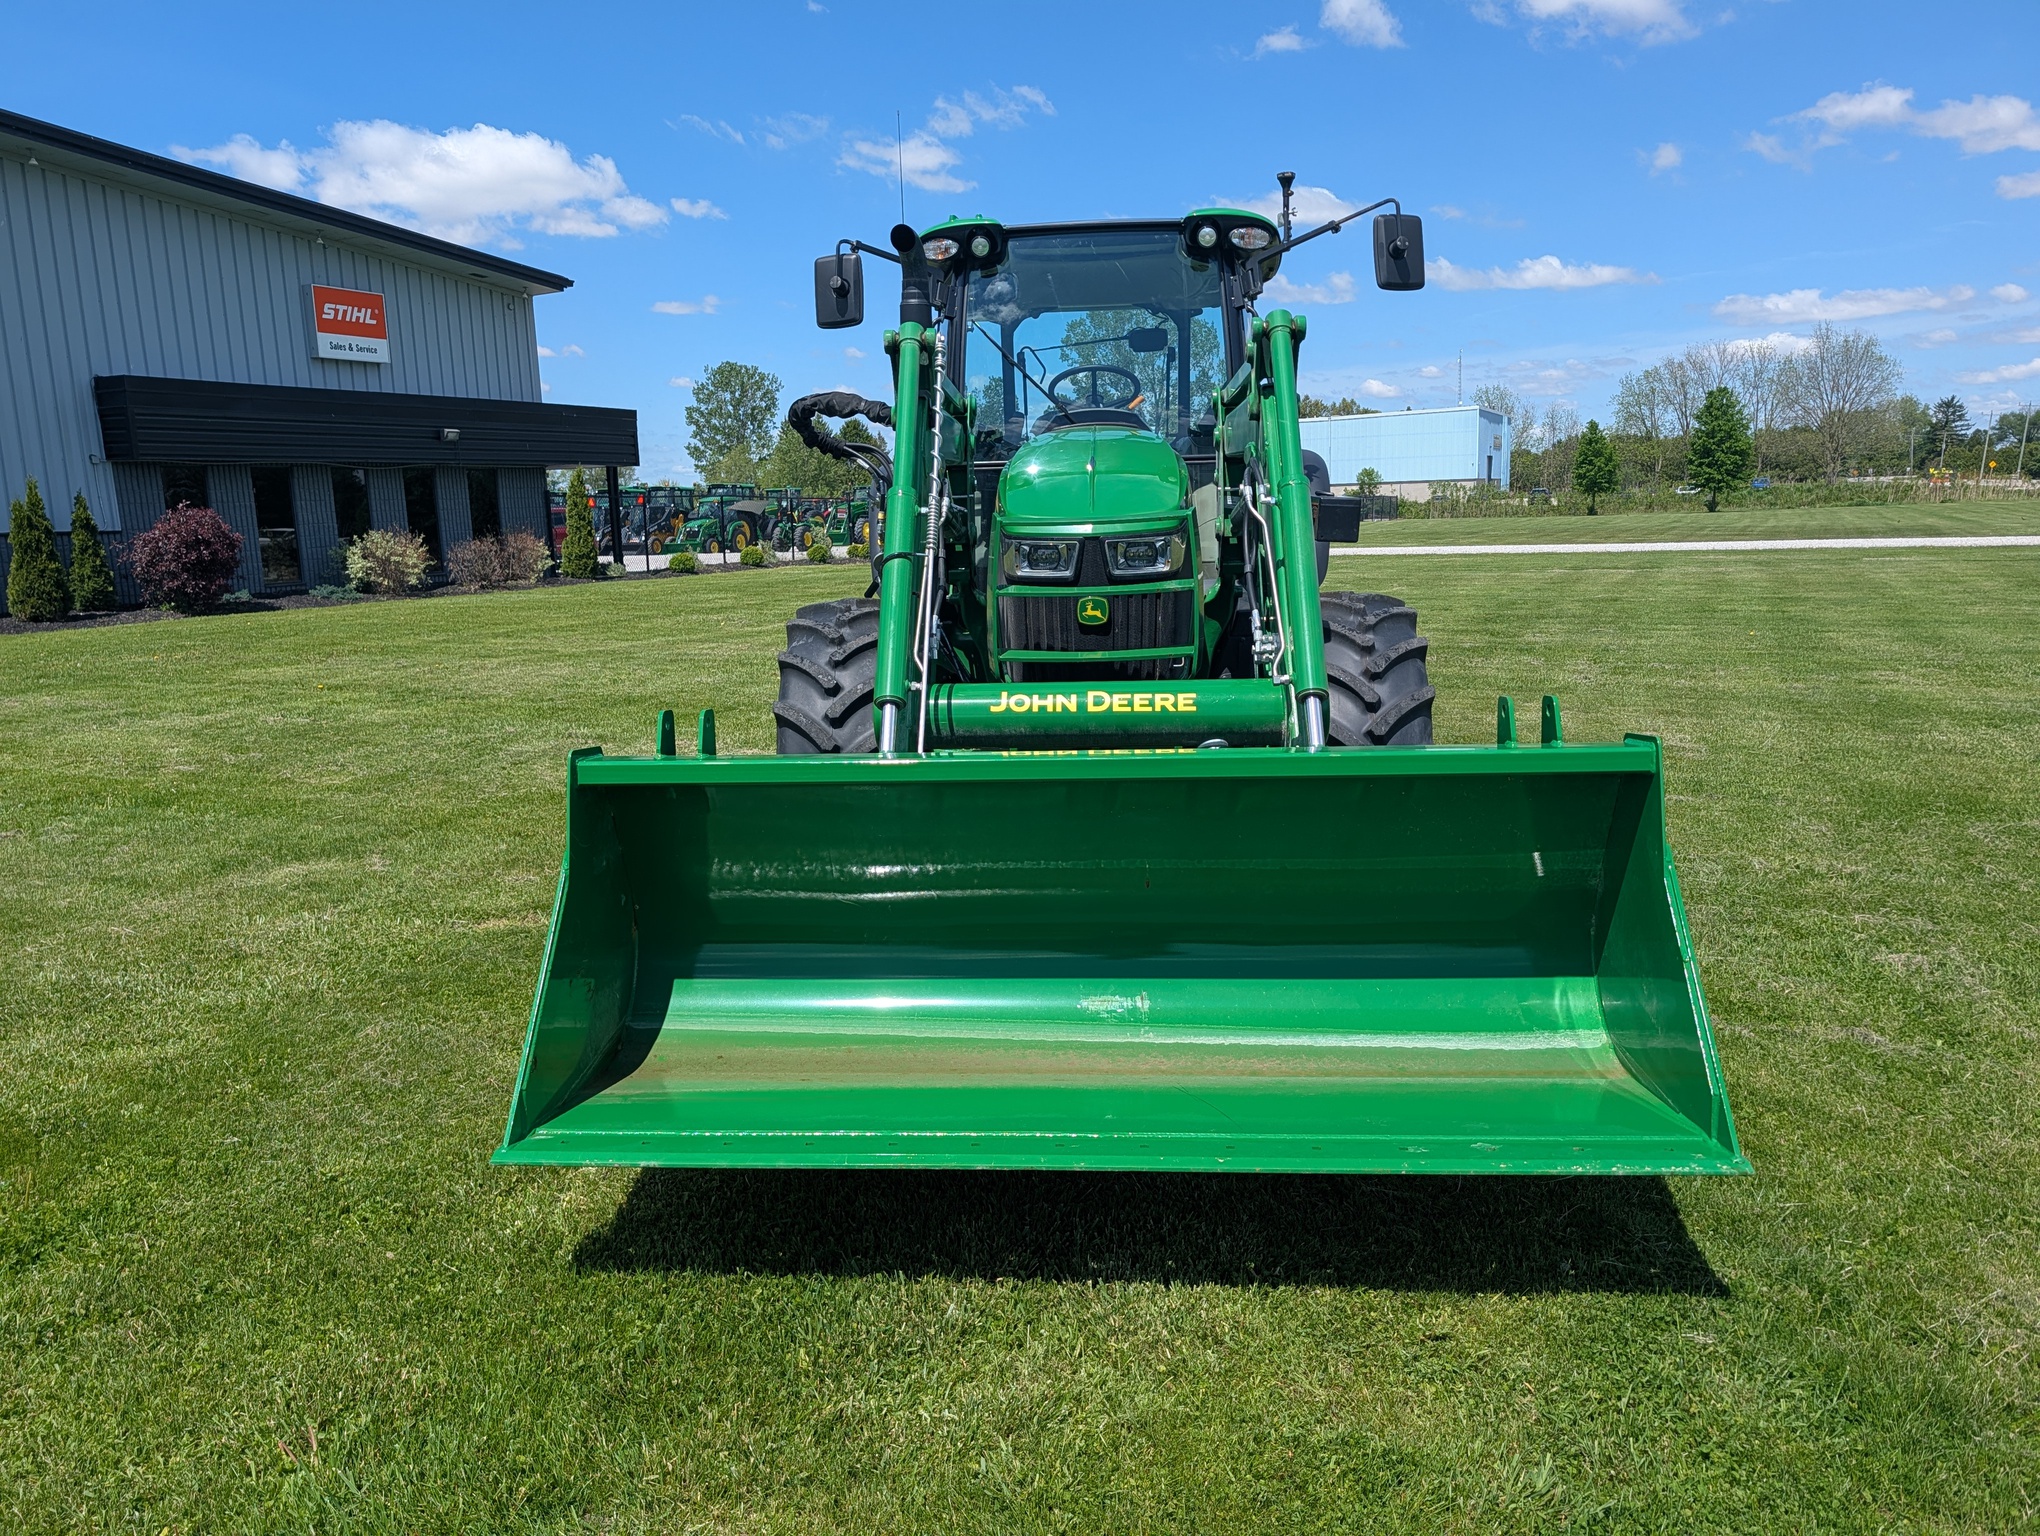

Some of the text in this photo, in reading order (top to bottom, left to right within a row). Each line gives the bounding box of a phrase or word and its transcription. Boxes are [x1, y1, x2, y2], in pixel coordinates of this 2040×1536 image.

[322, 303, 377, 324] STIHL
[329, 341, 378, 354] Sales & Service
[990, 690, 1197, 713] JOHN DEERE
